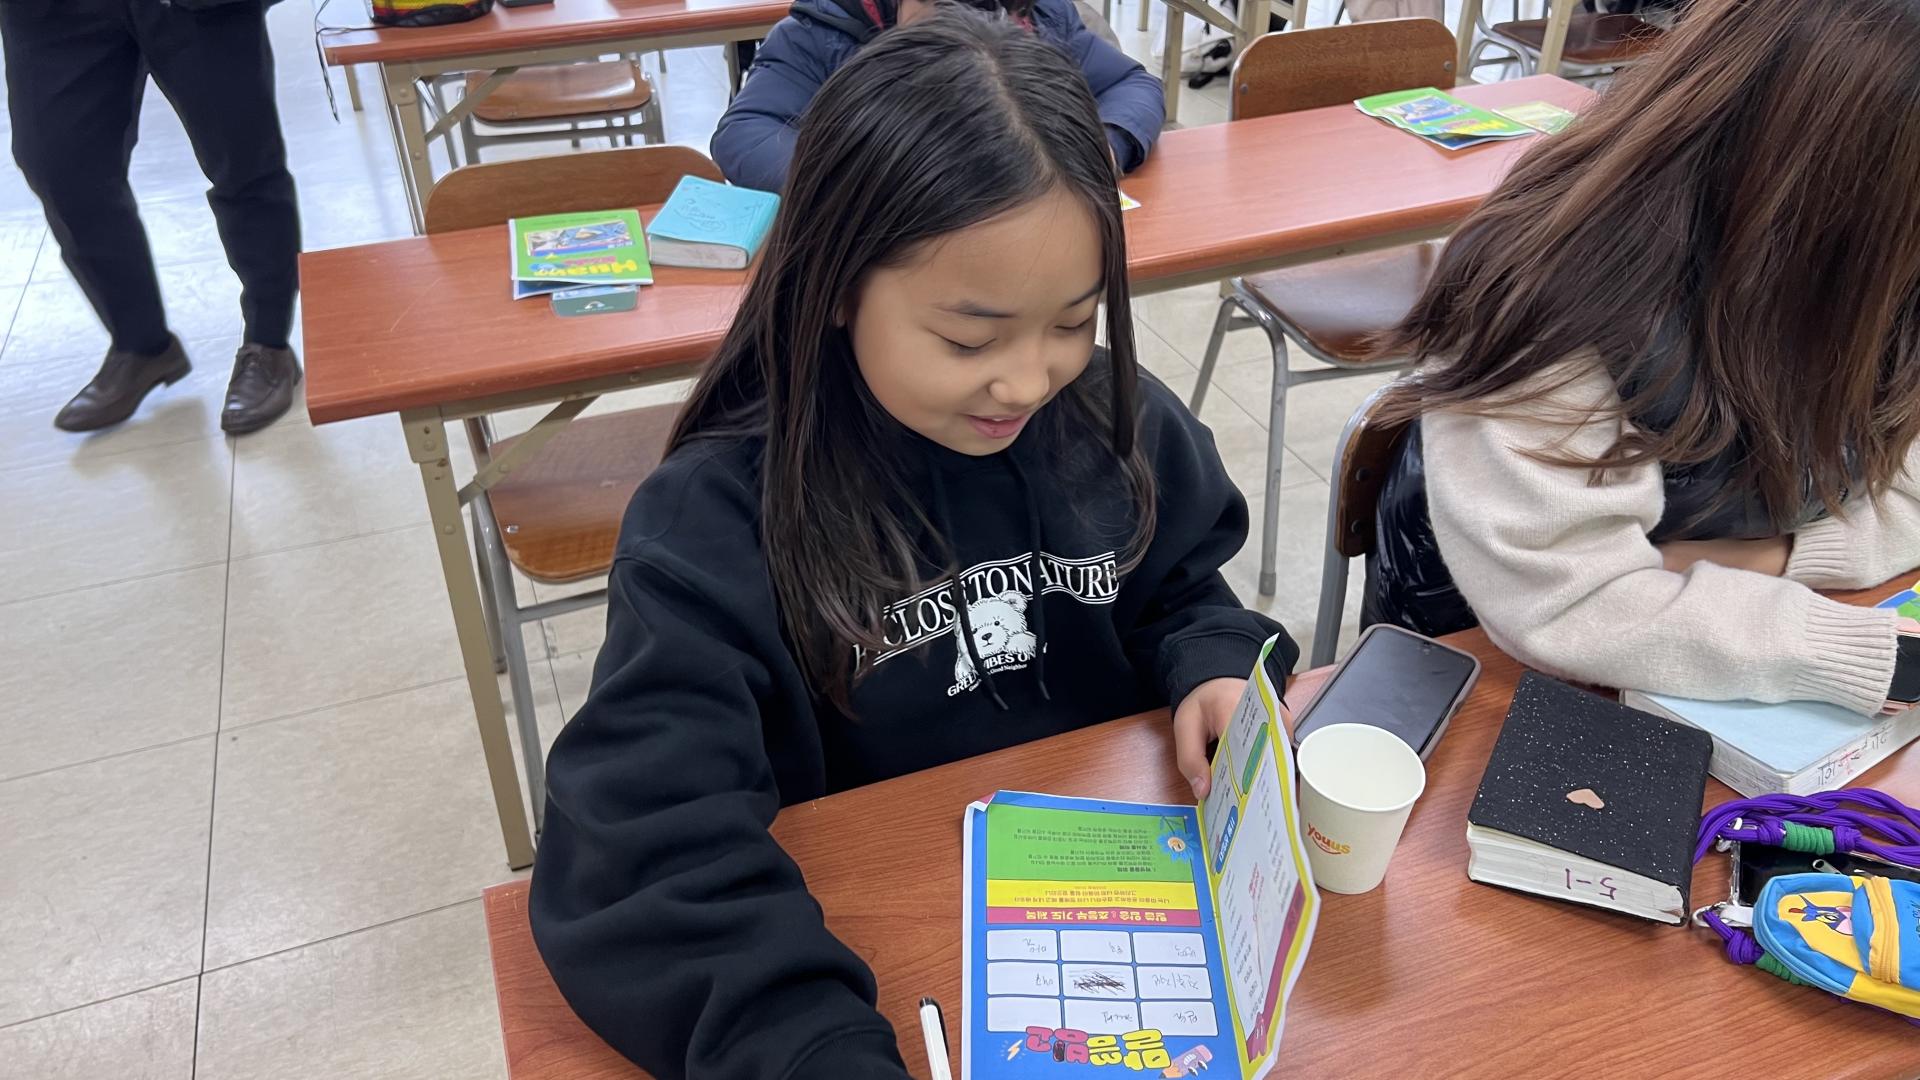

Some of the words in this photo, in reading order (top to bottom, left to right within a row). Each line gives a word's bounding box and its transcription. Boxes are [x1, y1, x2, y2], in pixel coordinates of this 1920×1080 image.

[883, 579, 966, 646] CLOS
[1565, 868, 1617, 901] 5-1
[1026, 910, 1049, 920] 제목
[1052, 910, 1074, 921] 기도
[1077, 910, 1110, 921] 초등부
[1119, 911, 1142, 921] 암송
[1144, 912, 1168, 922] 말씀
